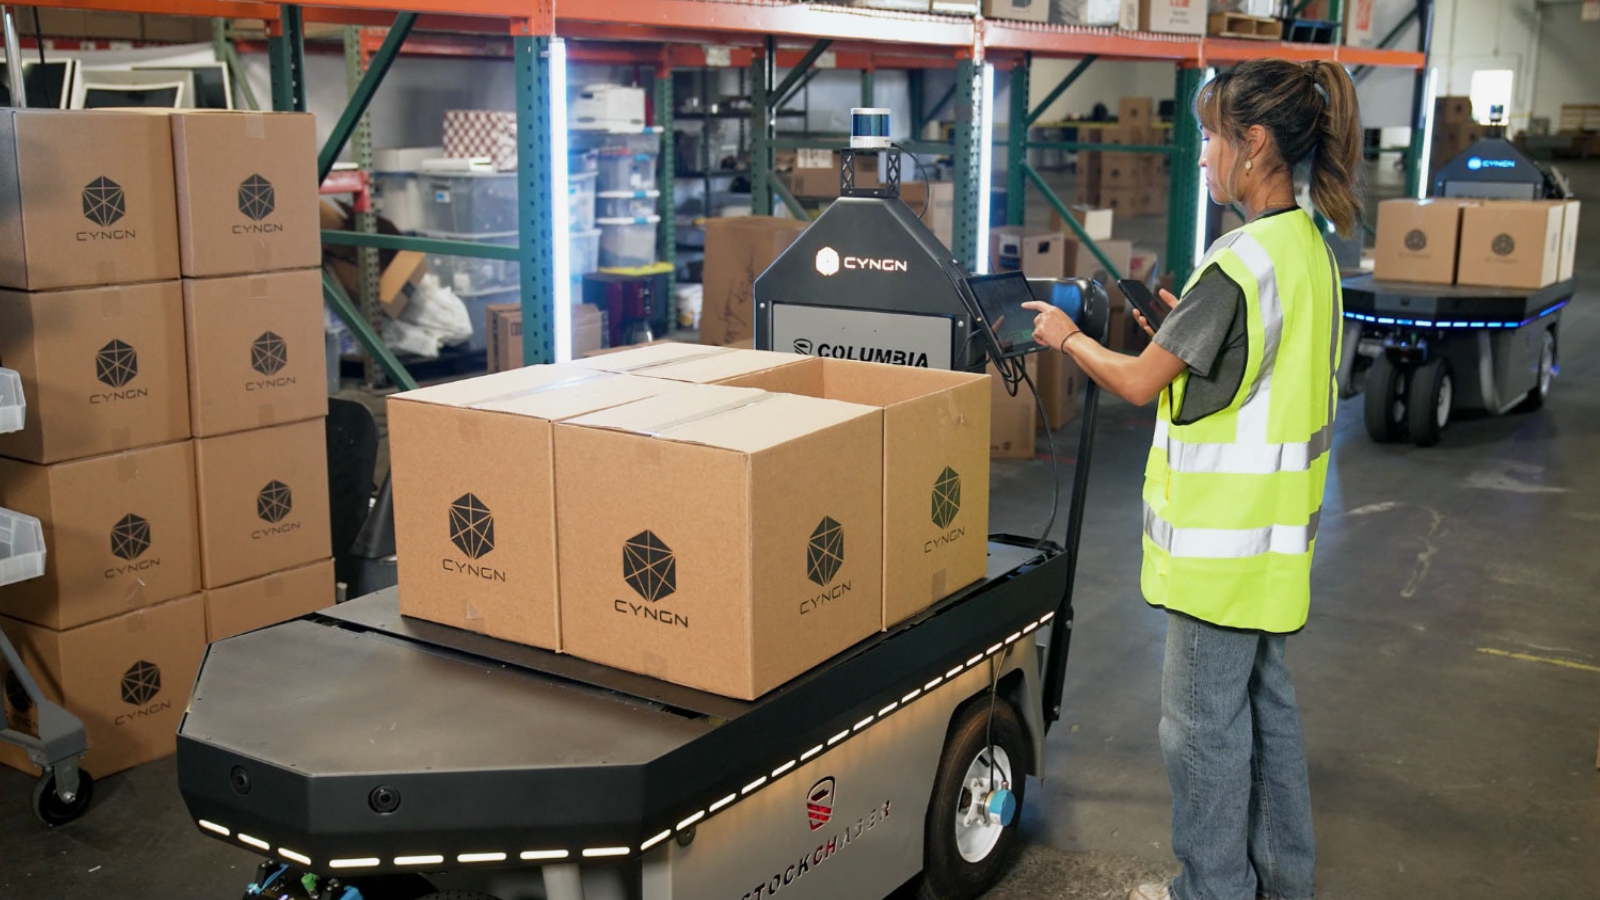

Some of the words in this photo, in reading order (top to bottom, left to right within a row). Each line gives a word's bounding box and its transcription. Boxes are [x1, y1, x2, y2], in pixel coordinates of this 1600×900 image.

[76, 229, 136, 242] CYNGN
[231, 223, 283, 235] CYNGN
[844, 256, 908, 272] CYNGN
[818, 343, 929, 368] COLUMBIA
[245, 376, 296, 392] CYNGN
[89, 388, 148, 404] CYNGN
[251, 521, 300, 540] CYNGN
[923, 526, 966, 554] CYNGN
[104, 558, 161, 579] CYNGN
[442, 558, 507, 583] CYNGN
[800, 580, 852, 615] CYNGN
[614, 599, 689, 628] CYNGN
[114, 700, 171, 727] CYNGN
